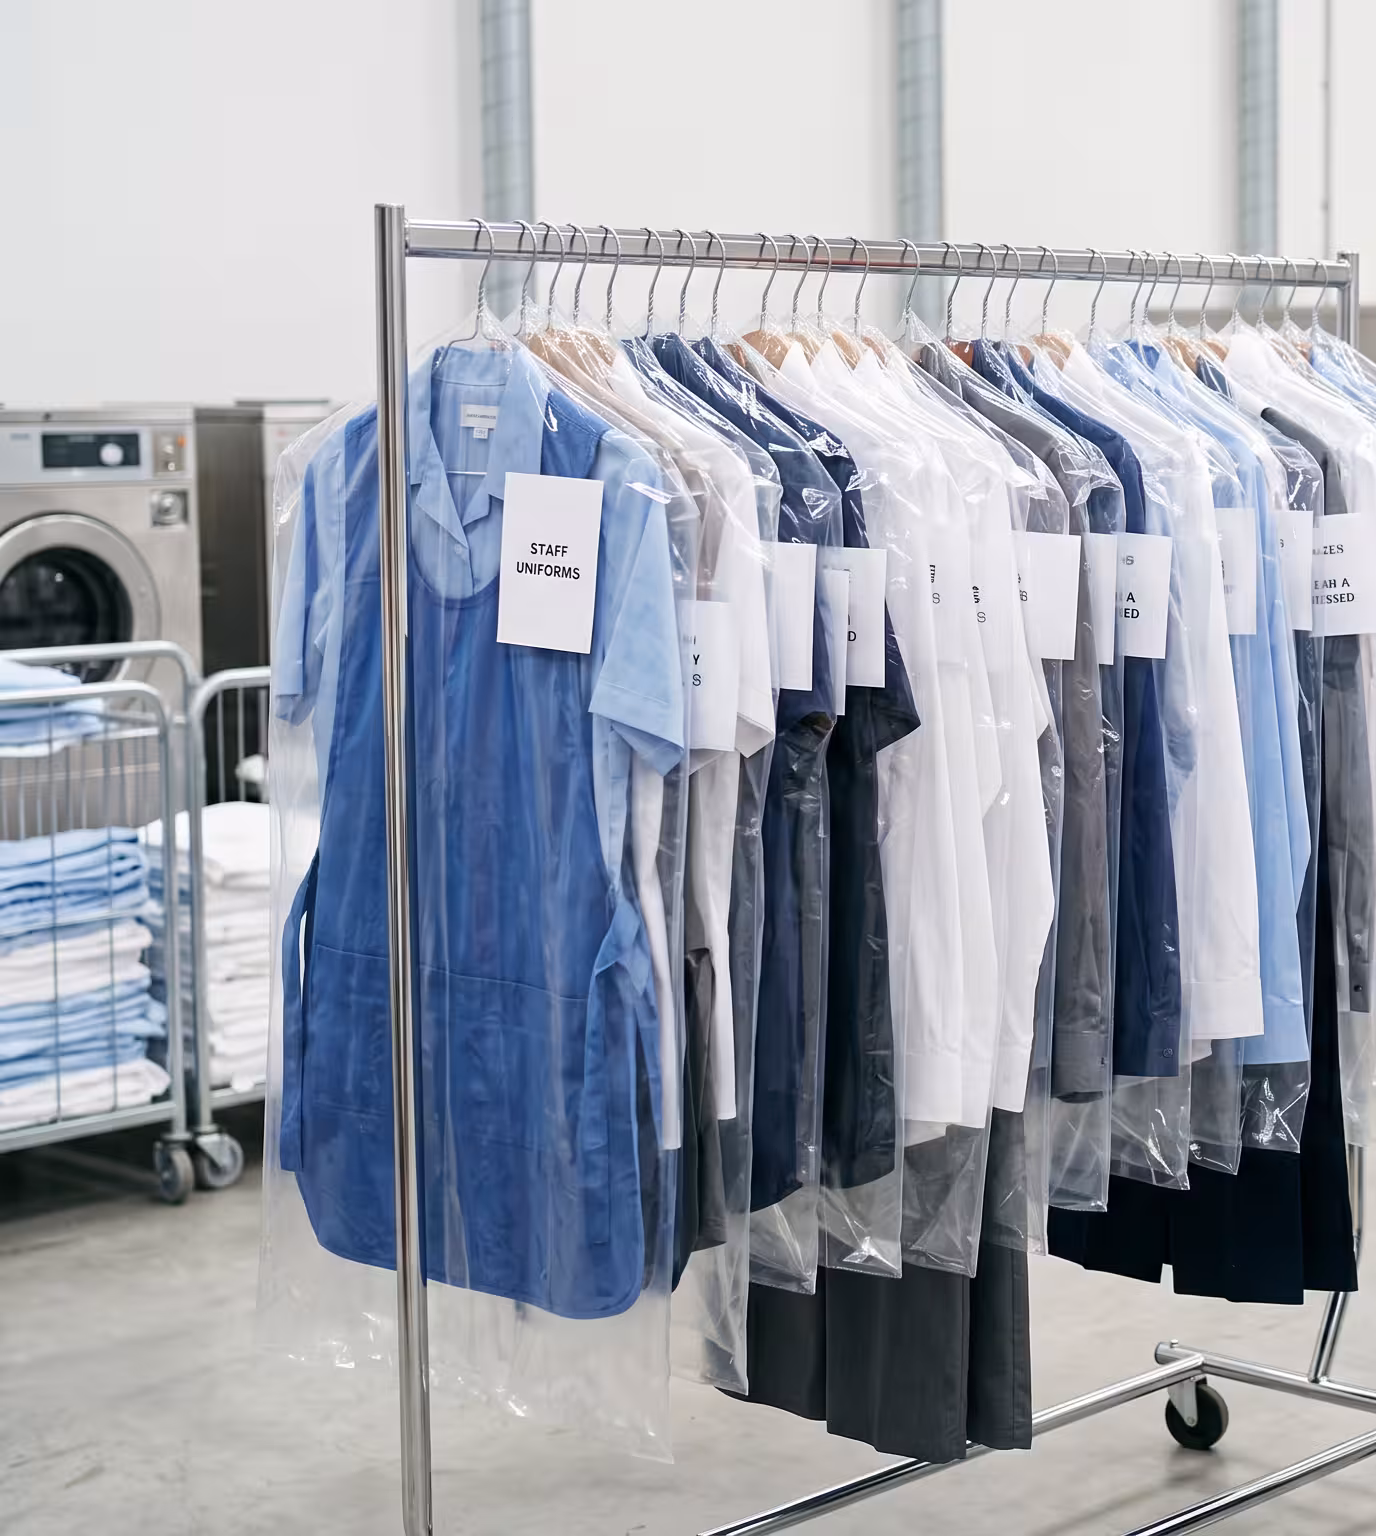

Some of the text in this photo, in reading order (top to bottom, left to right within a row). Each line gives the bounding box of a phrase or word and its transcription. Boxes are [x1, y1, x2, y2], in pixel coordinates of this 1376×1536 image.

[530, 542, 568, 557] STAFF
[516, 561, 581, 580] UNIFORMS
[1341, 577, 1350, 588] A
